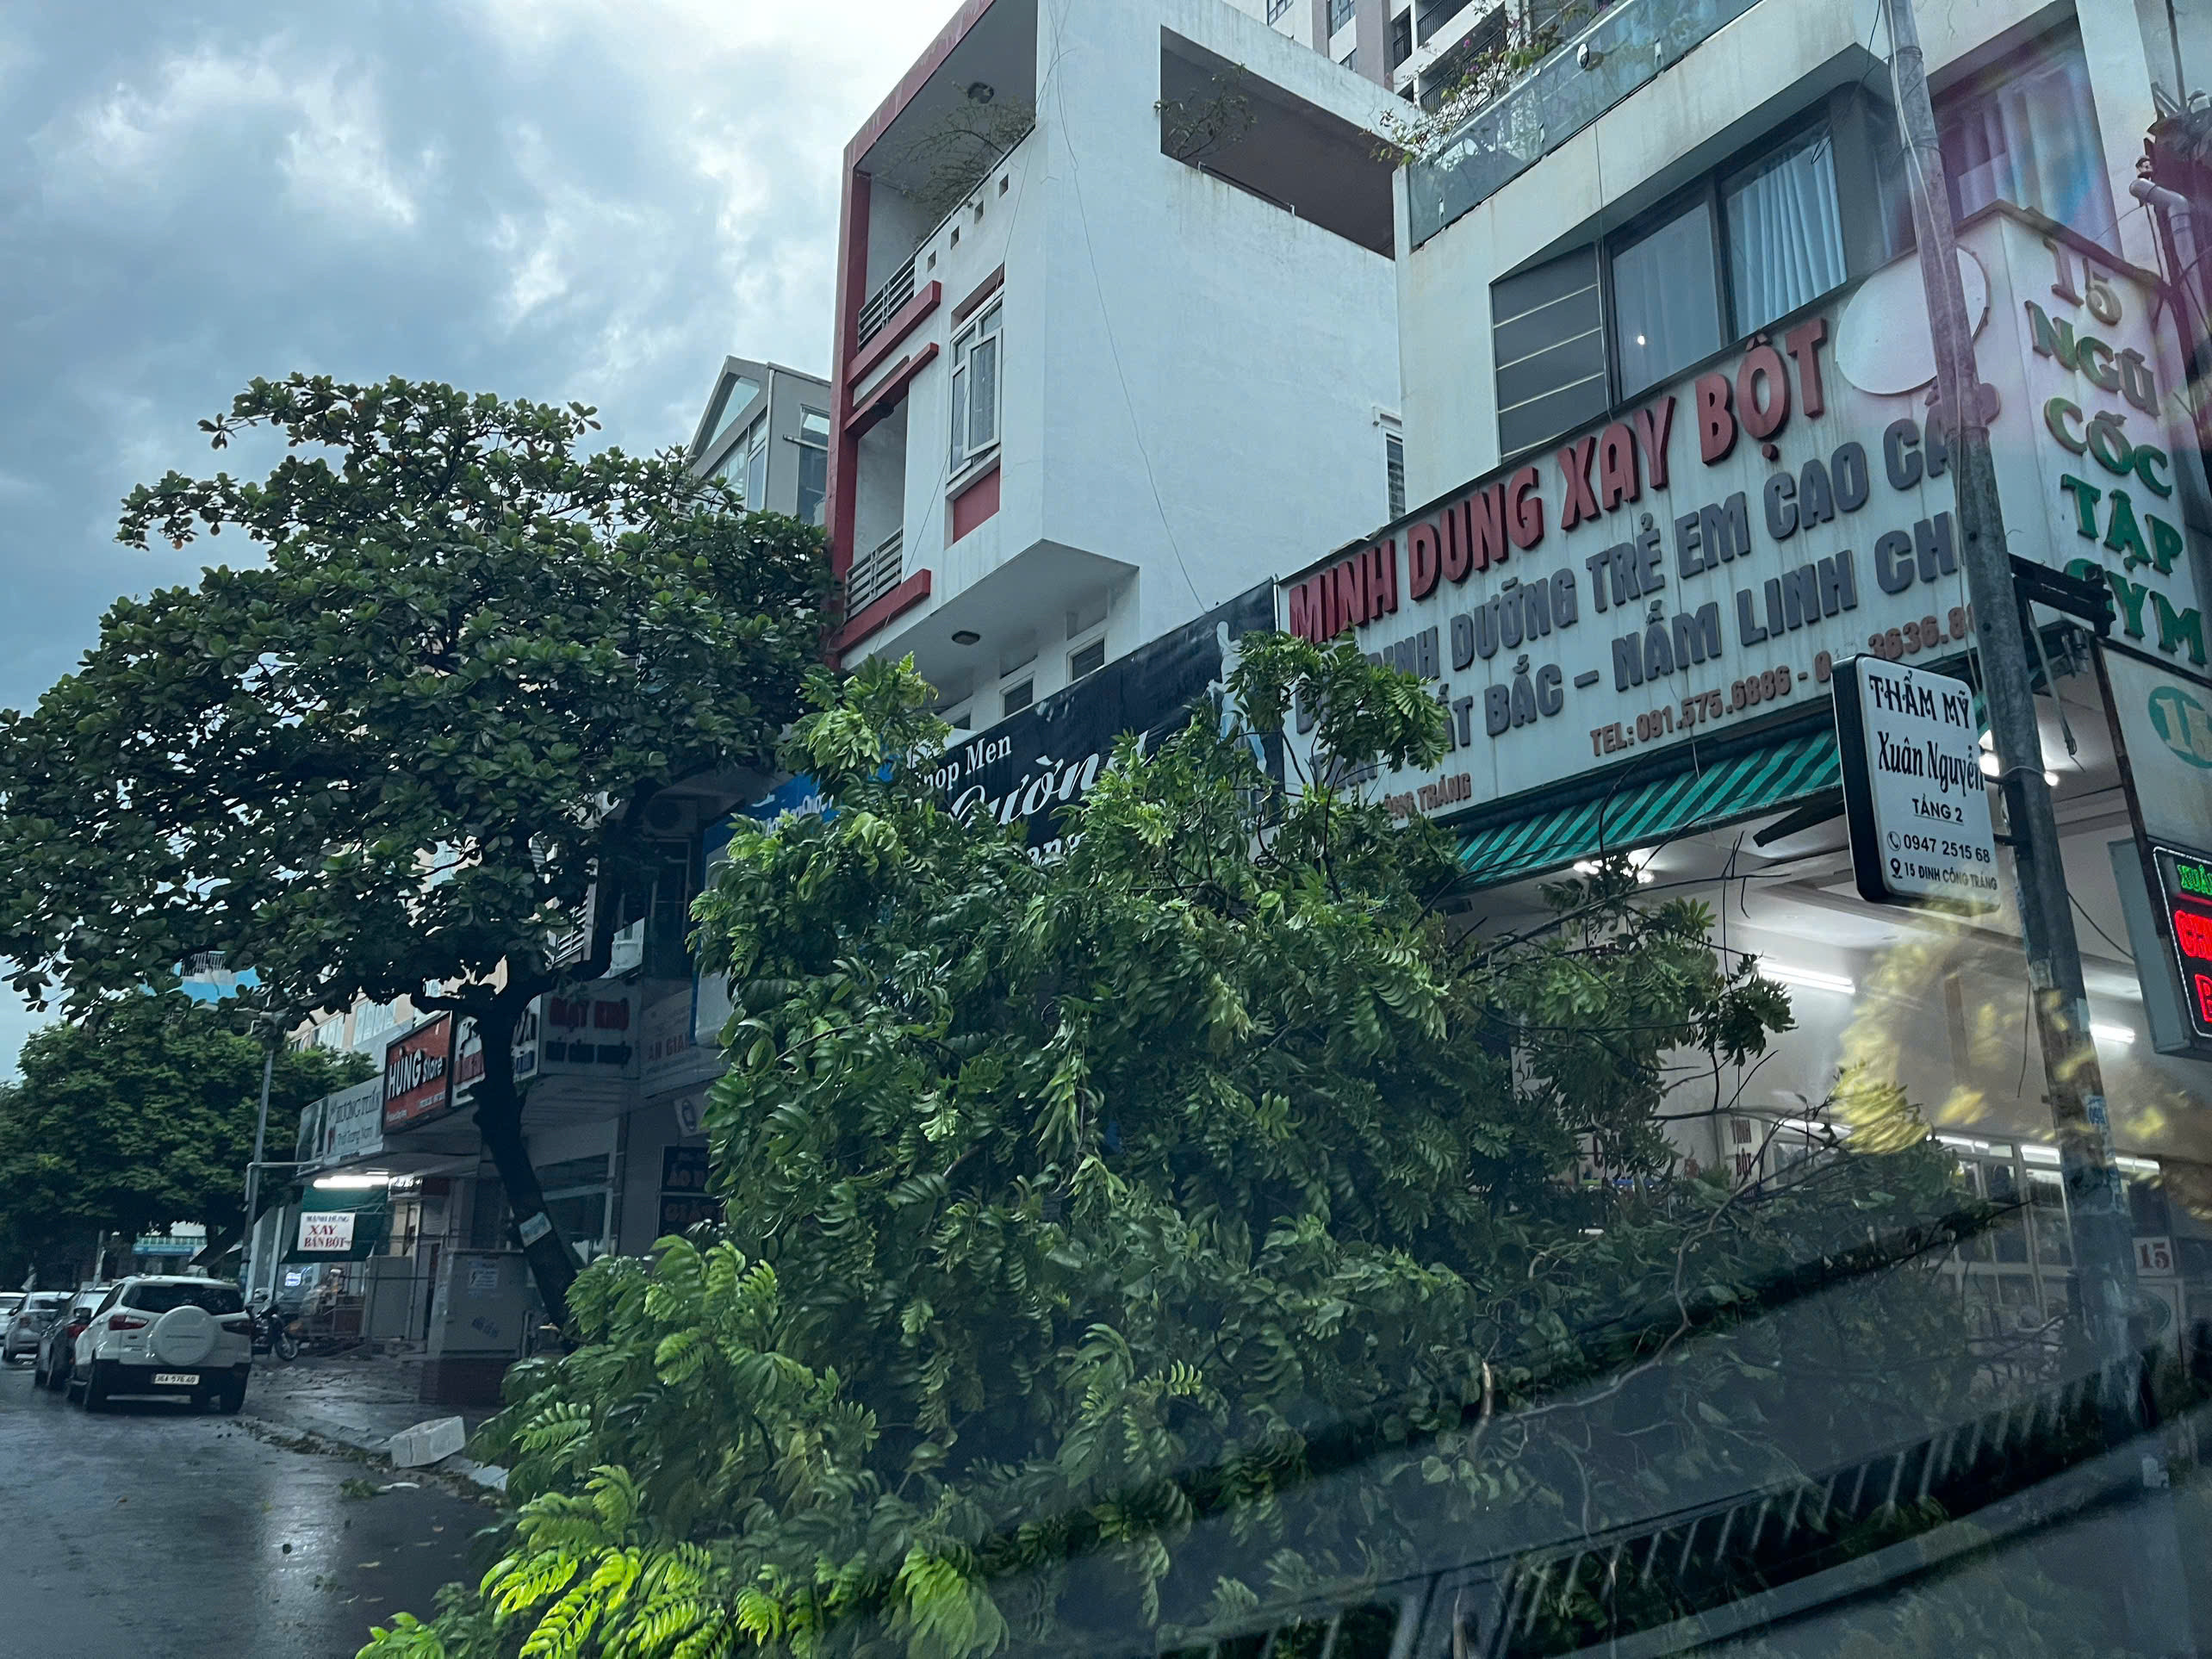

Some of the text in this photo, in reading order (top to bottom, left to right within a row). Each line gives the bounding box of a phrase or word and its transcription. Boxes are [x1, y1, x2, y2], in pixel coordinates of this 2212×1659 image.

[2041, 237, 2122, 326] 15
[1289, 317, 1829, 644] MINH DUNG XAY BỘT
[1450, 567, 1579, 672] DƯỠNG
[1586, 512, 1666, 613] TRẺ
[1674, 490, 1751, 581] EM
[1762, 440, 1870, 541] CAO
[1484, 653, 1564, 738] BẮC
[1611, 599, 1723, 693] NẤM
[1736, 549, 1859, 647] LINH
[1873, 510, 1959, 596] CH
[2064, 558, 2209, 668] YM
[1868, 669, 1971, 730] THẨM MỸ
[965, 735, 1012, 775] Men
[1877, 730, 1924, 777] Xuân
[1417, 772, 1472, 812] TRÁNG
[1954, 807, 1965, 823] 2
[1903, 833, 1991, 863] 0947 2515 68
[1904, 861, 1917, 878] 15
[1942, 867, 1970, 887] CÔNG
[1970, 872, 1998, 892] TRÁNG
[308, 1224, 337, 1235] XAY
[2141, 1242, 2171, 1270] 15
